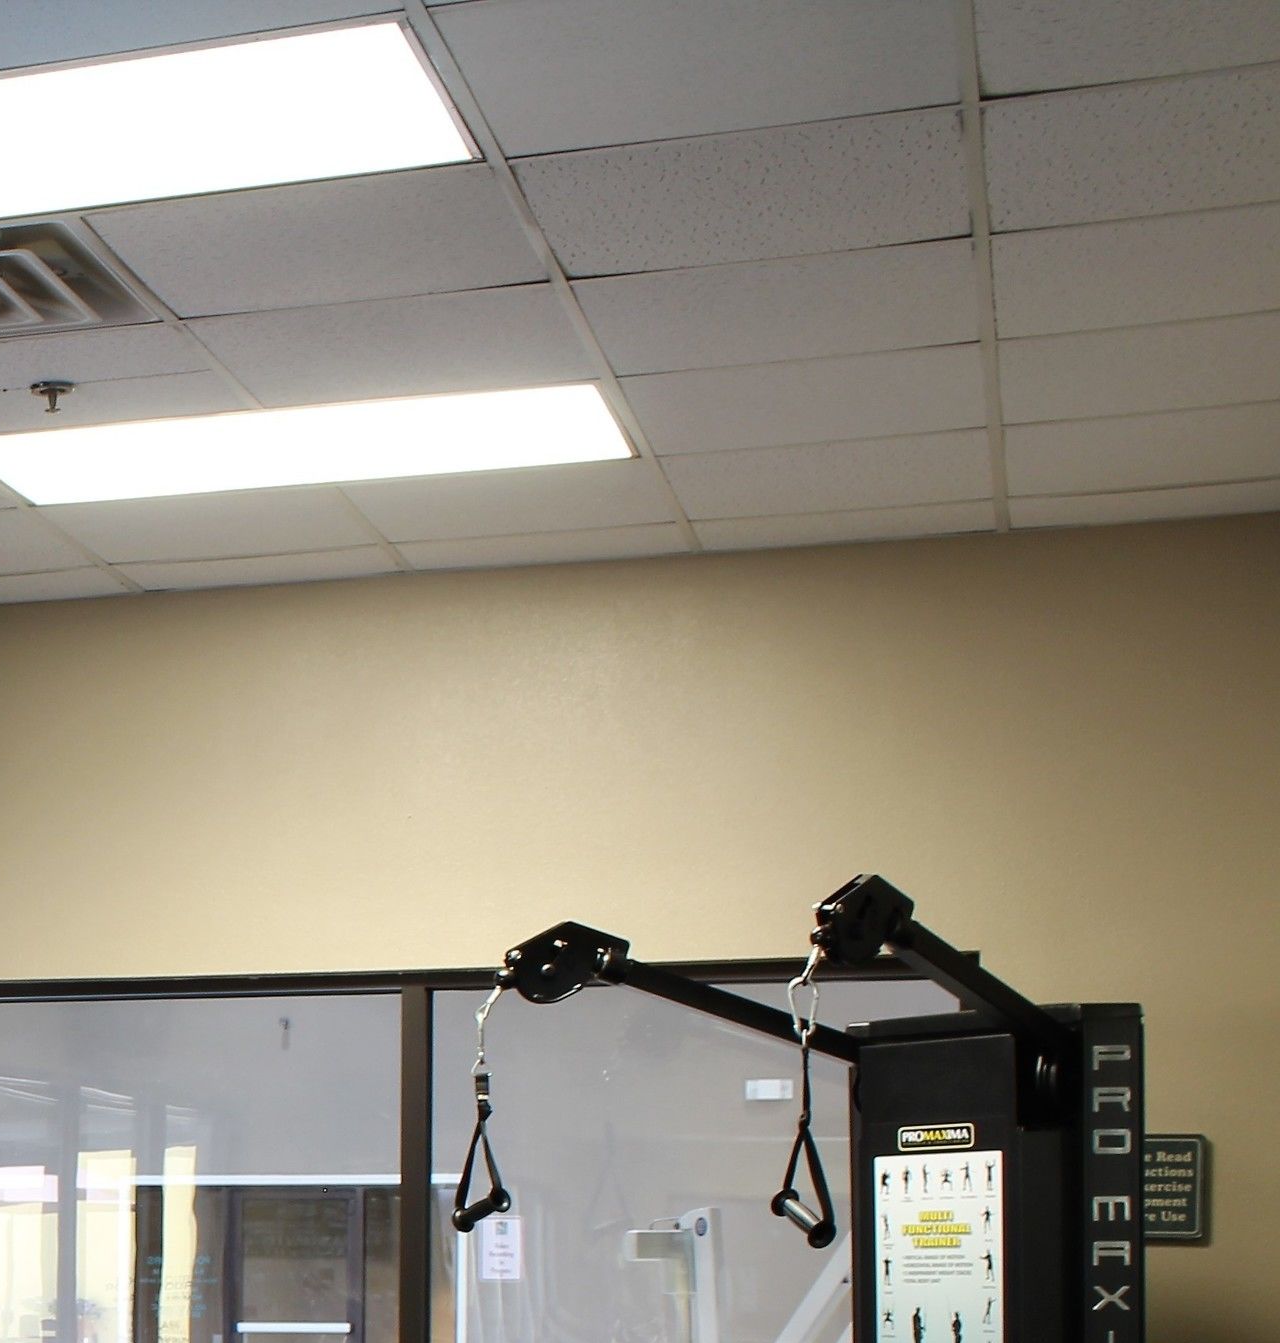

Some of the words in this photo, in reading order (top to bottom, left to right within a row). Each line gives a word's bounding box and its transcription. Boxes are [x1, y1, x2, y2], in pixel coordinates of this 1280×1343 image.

[1092, 1044, 1132, 1154] PRO
[901, 1128, 969, 1142] PROMAXIMA
[1155, 1151, 1193, 1162] Read
[1161, 1210, 1187, 1222] Use
